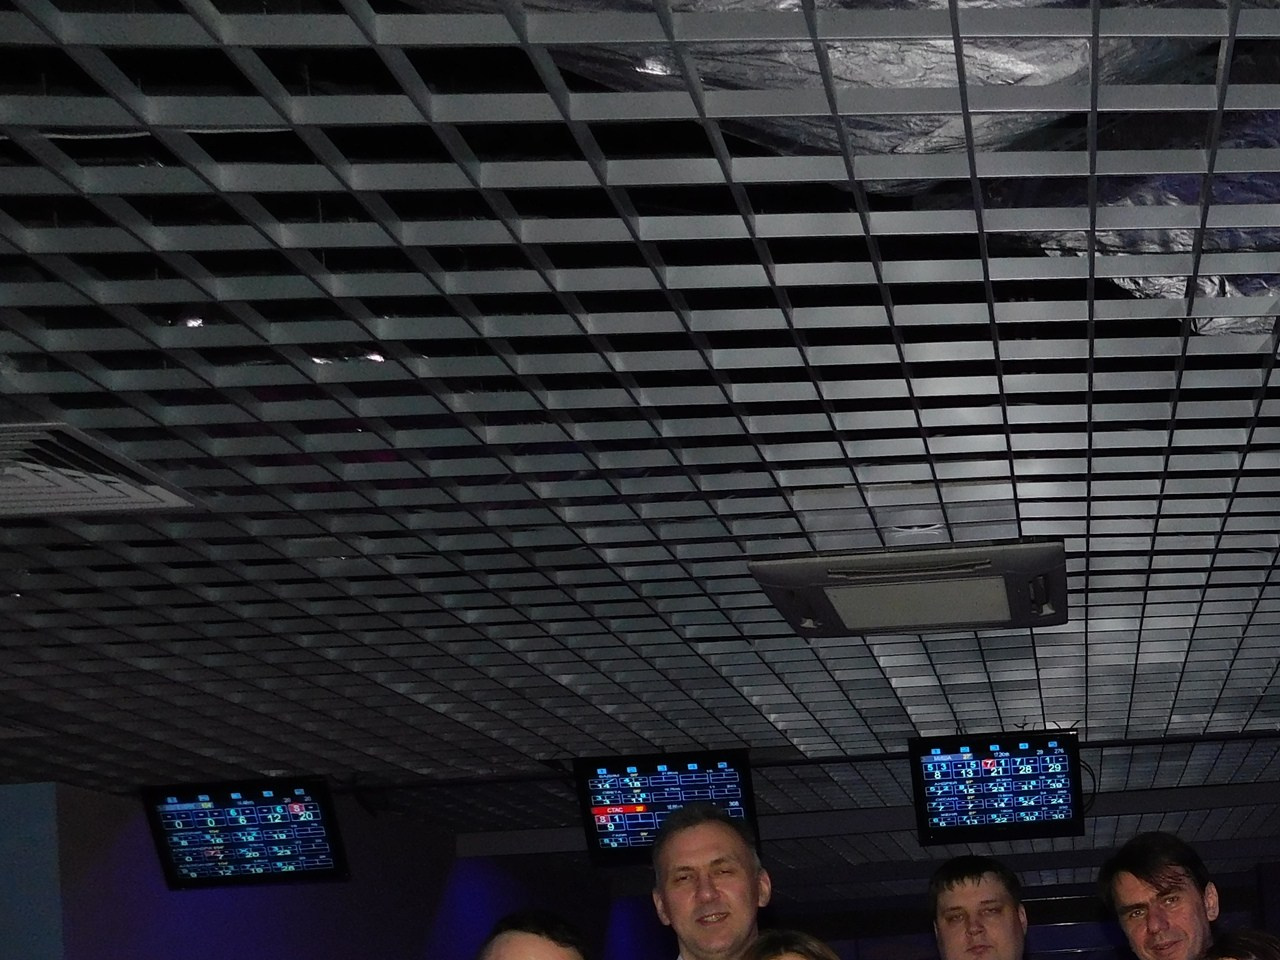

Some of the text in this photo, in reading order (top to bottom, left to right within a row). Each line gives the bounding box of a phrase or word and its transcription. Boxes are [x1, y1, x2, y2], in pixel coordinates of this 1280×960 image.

[985, 760, 992, 768] 7
[934, 764, 1061, 779] 8 13 21 28 29
[230, 808, 237, 816] 6
[176, 812, 313, 829] 0 0 6 12 20
[607, 823, 614, 831] 9
